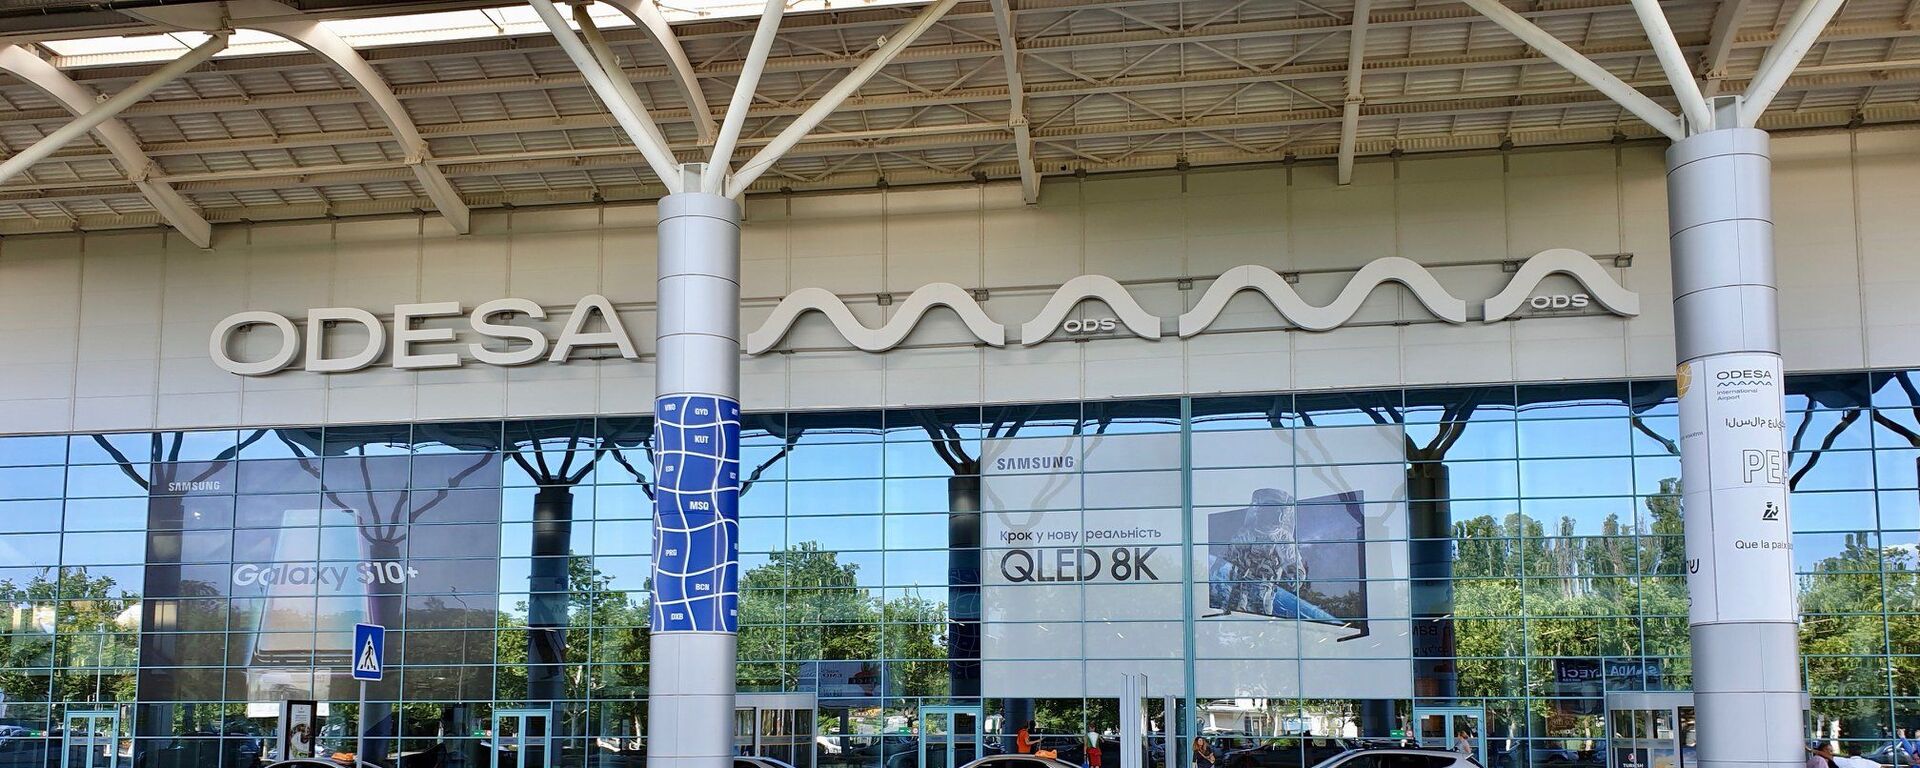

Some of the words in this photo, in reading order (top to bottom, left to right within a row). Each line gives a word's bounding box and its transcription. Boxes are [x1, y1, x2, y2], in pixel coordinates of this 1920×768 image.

[1531, 294, 1589, 308] ODS
[1064, 318, 1116, 332] ODS
[209, 294, 641, 376] ODESA
[1717, 370, 1772, 380] ODESA
[694, 435, 709, 444] KUT
[997, 456, 1074, 470] SAMSUNG
[168, 481, 221, 492] SAMSUNG
[689, 501, 710, 511] MSQ
[1000, 529, 1033, 544] Крок
[1036, 531, 1045, 543] у
[1047, 530, 1080, 543] нову
[1085, 527, 1162, 542] реальність
[1735, 540, 1759, 549] Que
[1761, 540, 1770, 549] la
[1000, 549, 1102, 583] QLED
[1110, 547, 1159, 582] 8K
[232, 563, 349, 592] Galaxy
[355, 561, 419, 584] S10+
[695, 583, 710, 591] BCN
